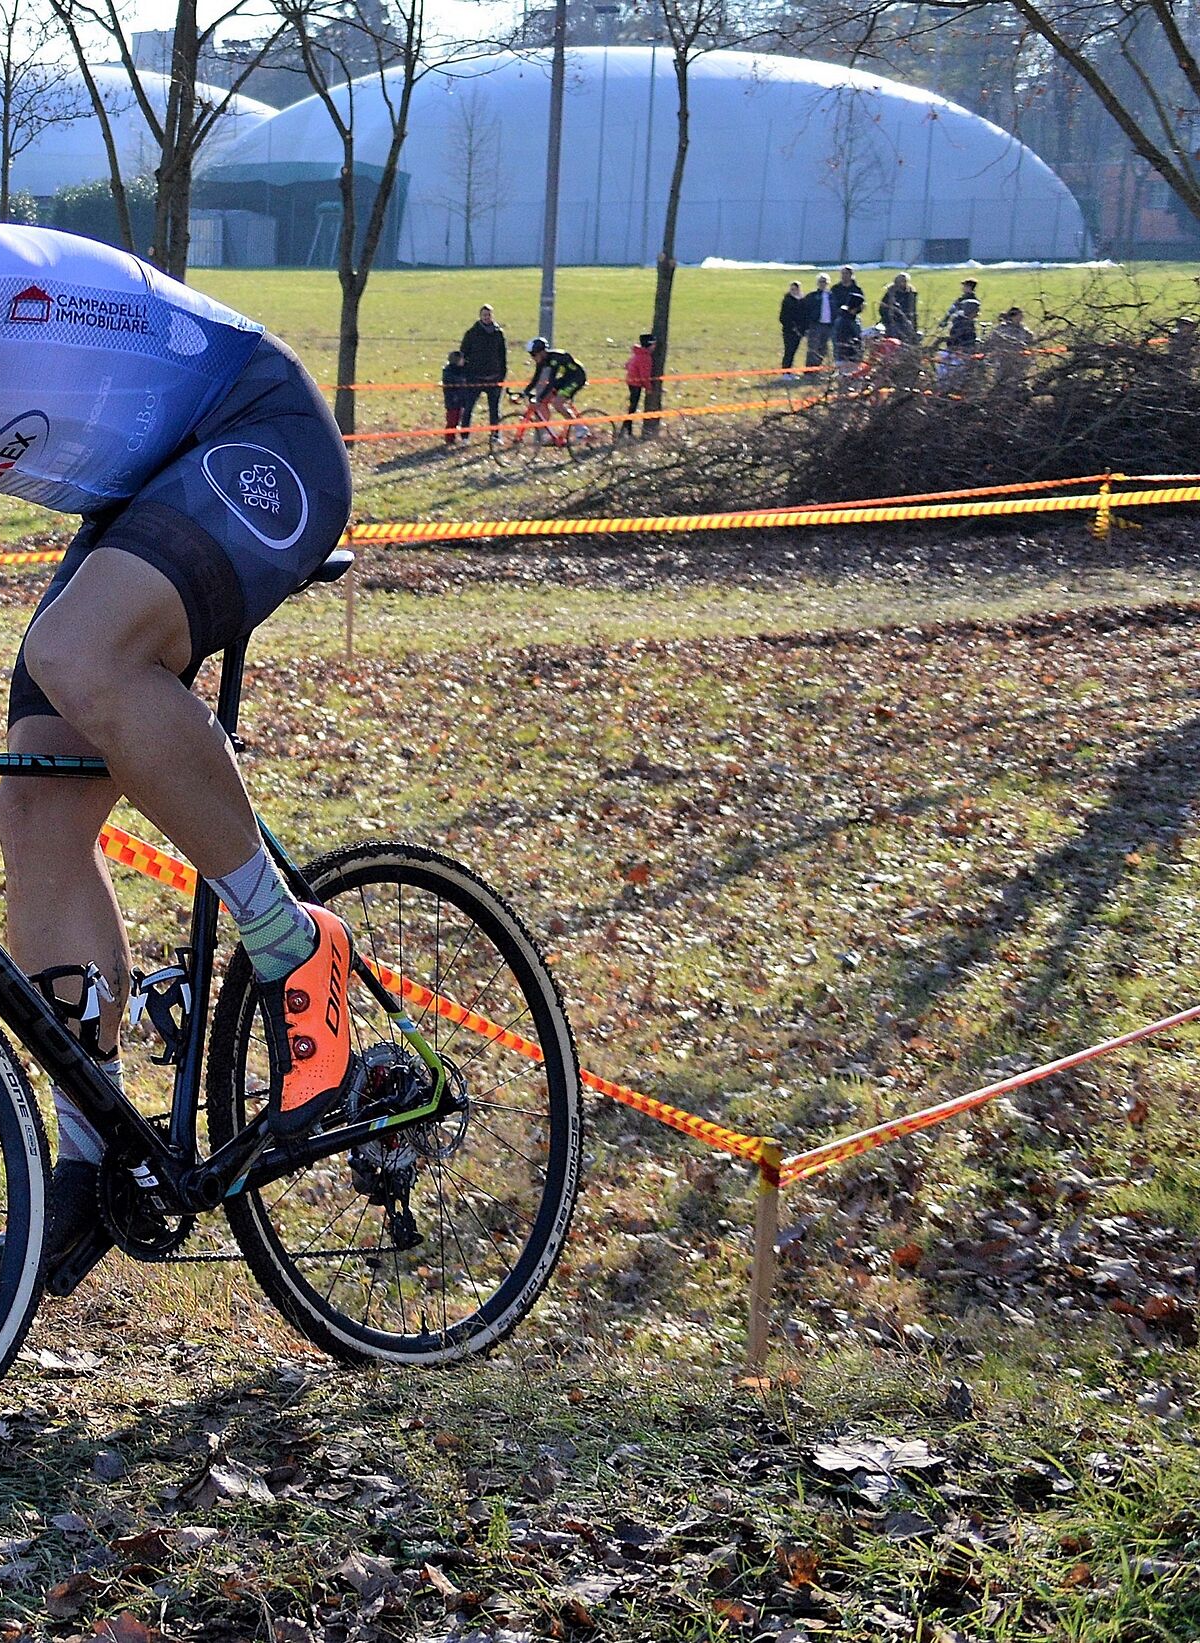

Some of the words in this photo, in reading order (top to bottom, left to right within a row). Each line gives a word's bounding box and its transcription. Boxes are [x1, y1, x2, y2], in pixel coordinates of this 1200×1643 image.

[56, 294, 147, 318] CAMPADELLI
[55, 308, 150, 335] IMMOBILIARE
[239, 482, 280, 501] Dubai
[243, 495, 281, 515] TOUR
[555, 1116, 578, 1236] SCHWALBE
